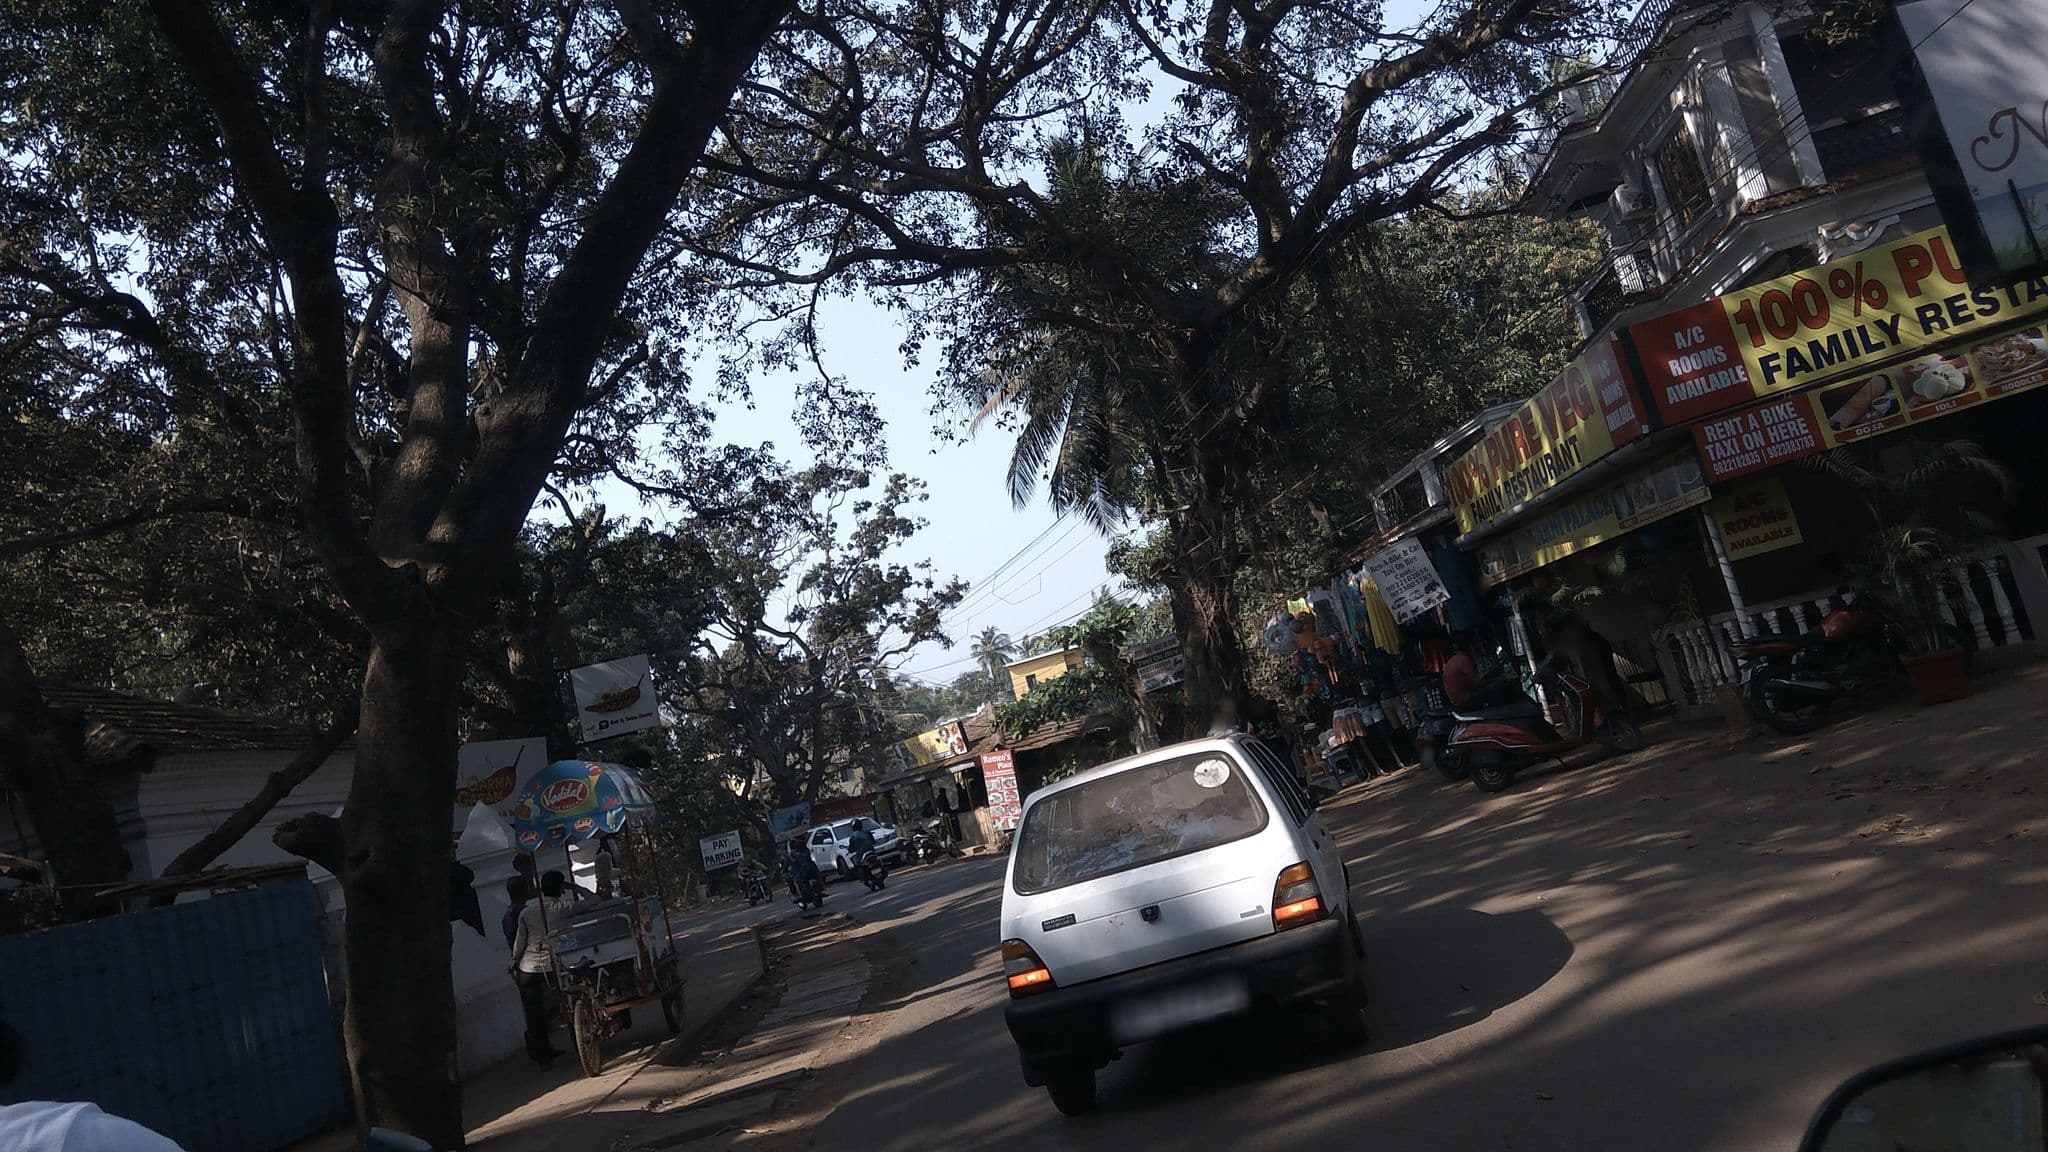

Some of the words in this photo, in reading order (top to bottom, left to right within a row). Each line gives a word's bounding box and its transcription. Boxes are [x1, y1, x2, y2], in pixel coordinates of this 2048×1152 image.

[1733, 261, 1888, 347] 100%
[1674, 325, 1705, 350] A/C
[1758, 313, 1901, 385] FAMILY
[1668, 345, 1727, 378] ROOMS
[1665, 364, 1748, 405] AVAILABLE
[2000, 374, 2044, 392] NOODLES
[1935, 400, 1957, 412] IDLI
[1485, 406, 1543, 481] PURE
[1536, 367, 1595, 440] VEG
[1704, 417, 1744, 442] RENT
[1748, 413, 1760, 430] A
[1760, 401, 1798, 426] BIKE
[1855, 422, 1886, 436] DOSA
[1705, 437, 1740, 461] TAXI
[1742, 430, 1766, 450] ON
[1766, 417, 1809, 443] HERE
[1470, 485, 1505, 525] FAMILY
[1503, 435, 1581, 501] RESTAURANT
[1730, 526, 1793, 551] AVAILABLE
[543, 782, 584, 806] Vadilal
[704, 848, 740, 865] PARKING
[713, 838, 728, 850] PAY
